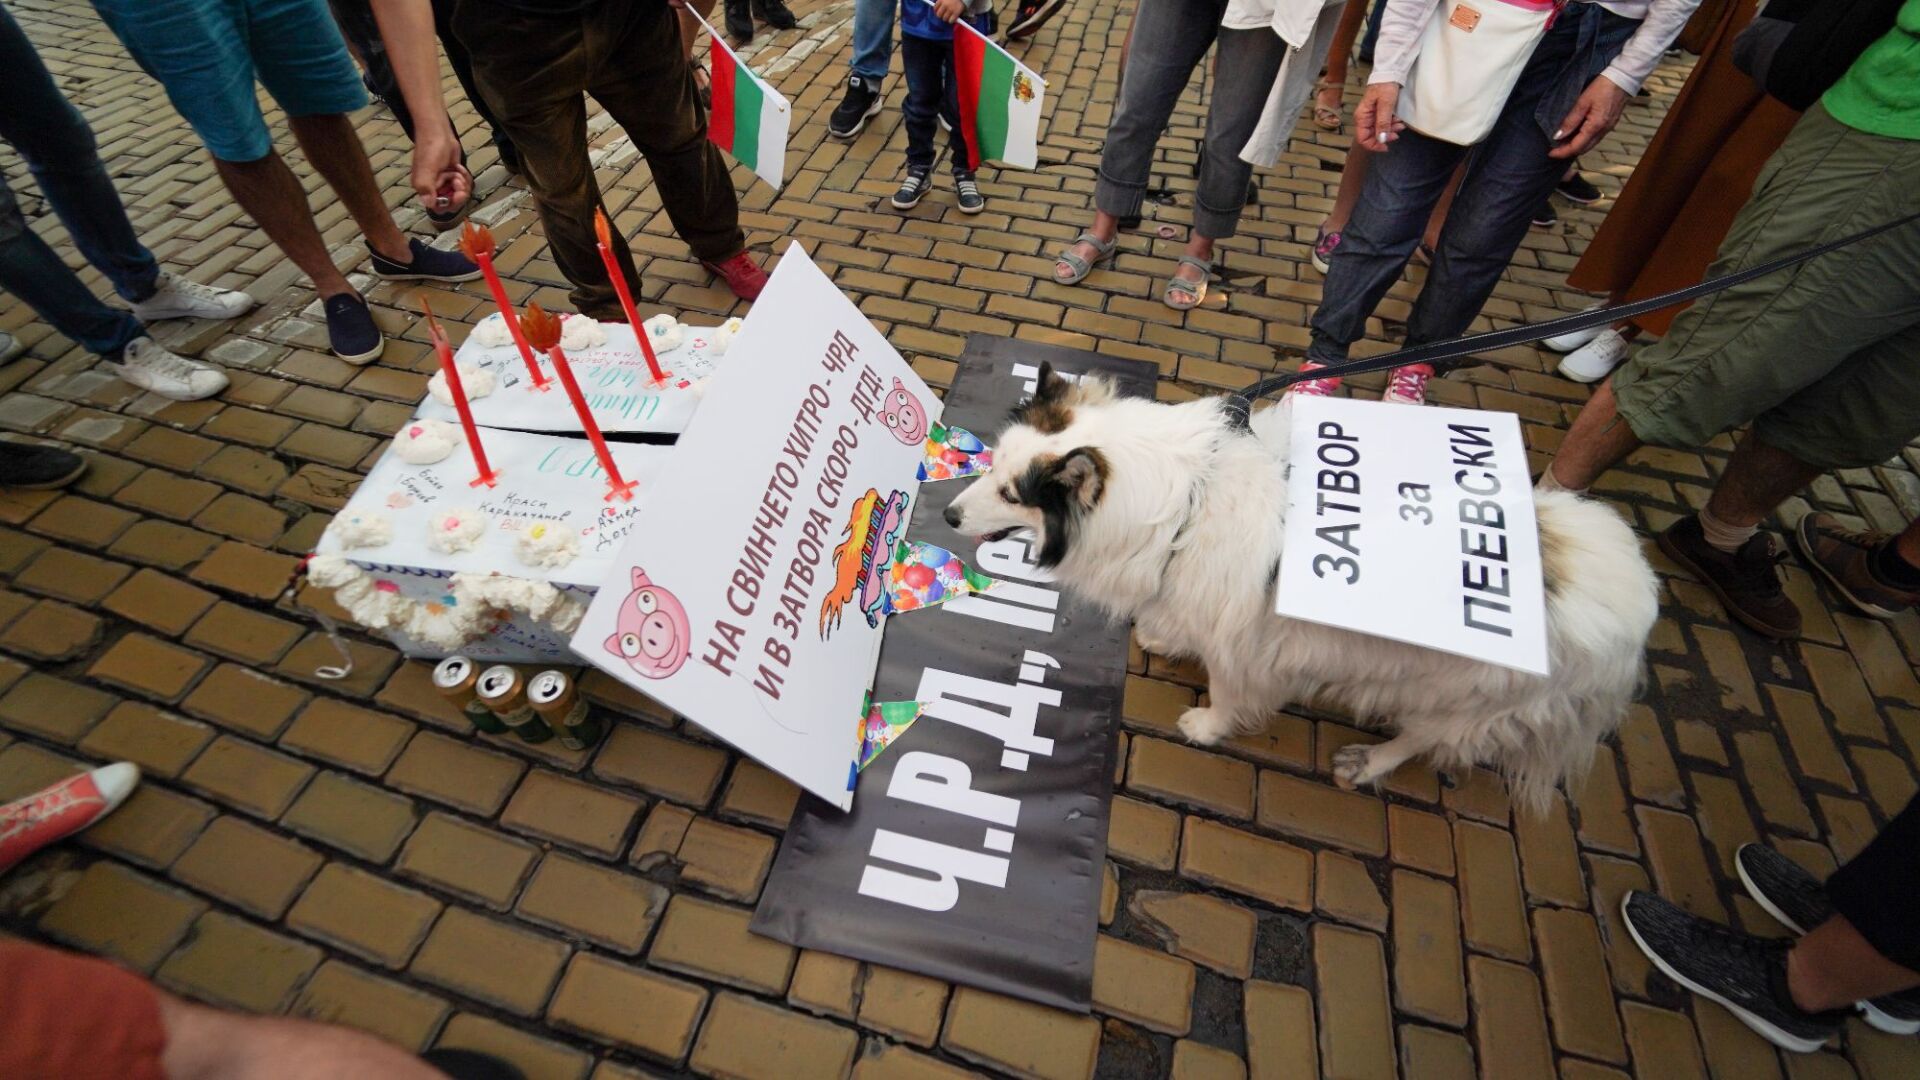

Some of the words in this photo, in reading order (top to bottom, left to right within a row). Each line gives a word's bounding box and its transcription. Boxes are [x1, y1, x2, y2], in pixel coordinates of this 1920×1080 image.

[850, 363, 885, 426] ДГД!
[702, 619, 747, 677] НА
[726, 461, 799, 617] СВИНЧЕТО
[782, 383, 831, 469] ХИТРО
[821, 329, 860, 374] ЧРД
[816, 424, 859, 509] СКОРО
[1312, 421, 1361, 586] ЗАТВОР
[1397, 481, 1434, 526] за
[1447, 423, 1513, 638] ПЕЕВСКИ
[773, 507, 833, 641] ЗАТВОРА
[753, 663, 785, 701] И
[763, 636, 792, 668] В
